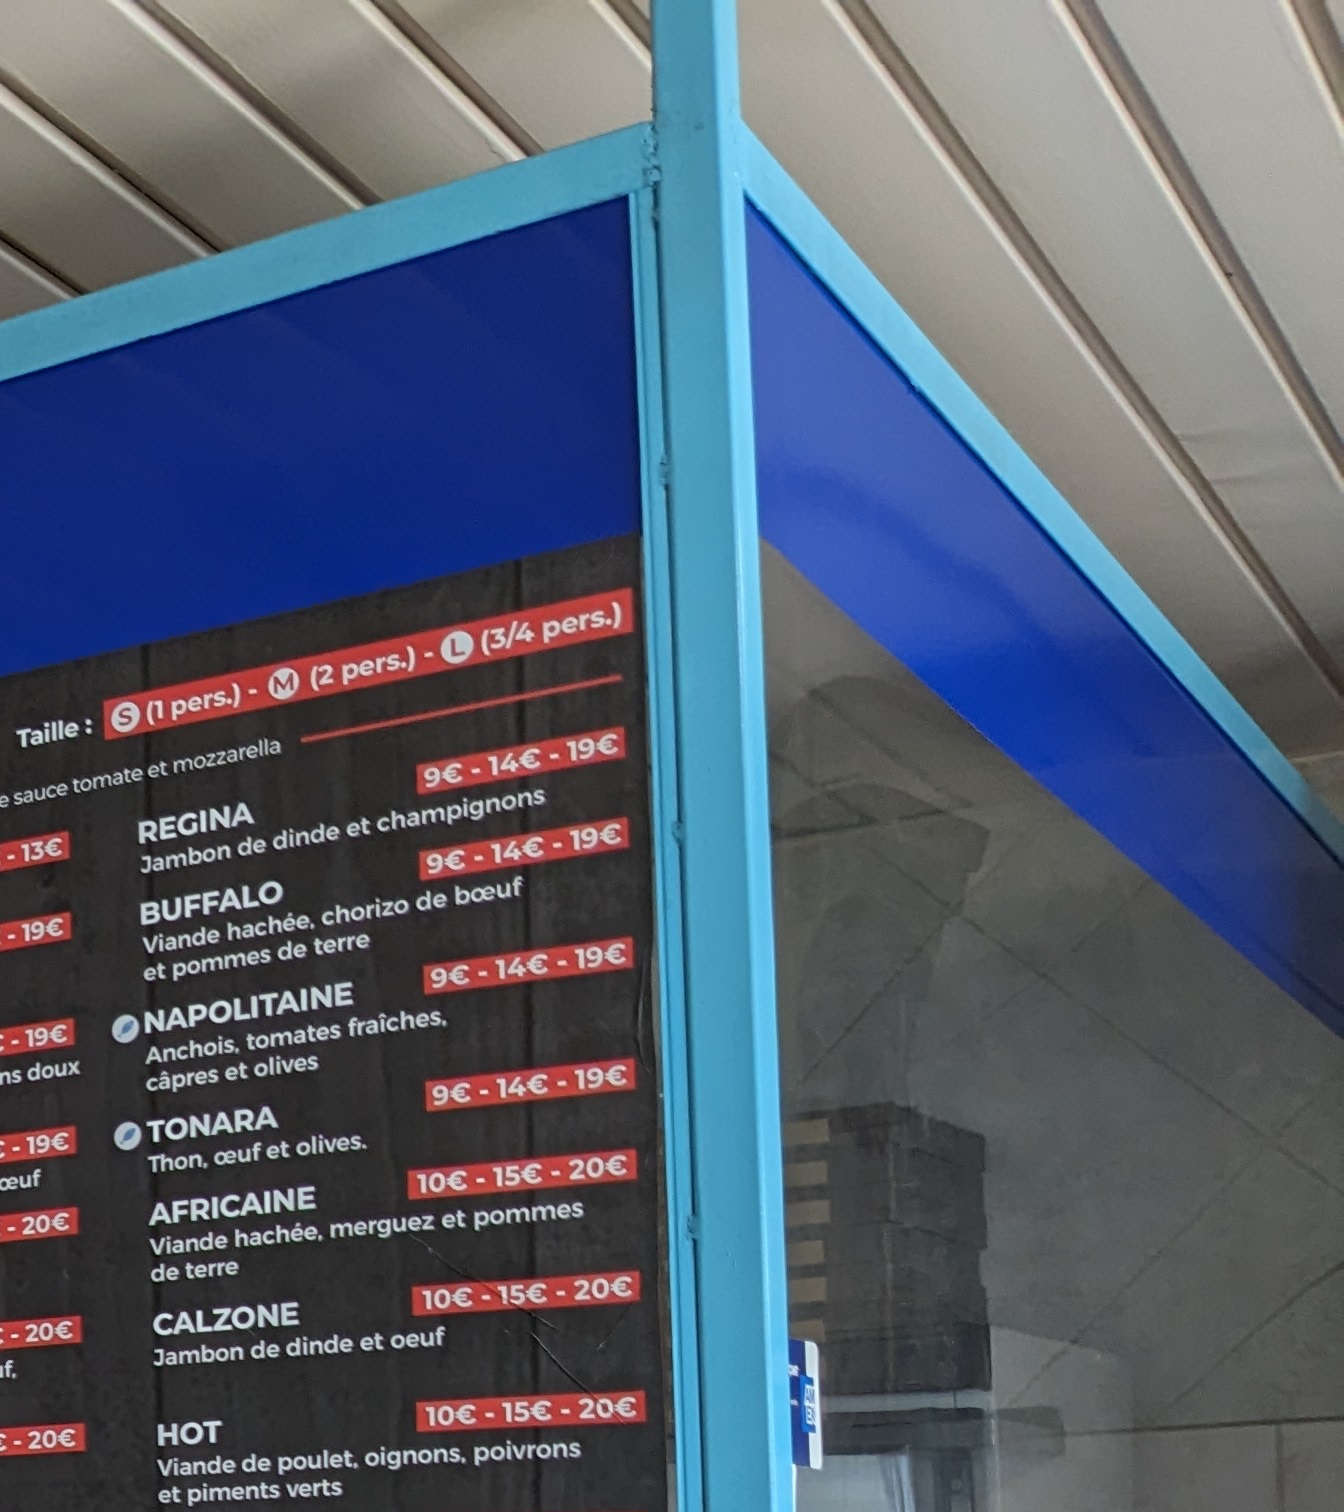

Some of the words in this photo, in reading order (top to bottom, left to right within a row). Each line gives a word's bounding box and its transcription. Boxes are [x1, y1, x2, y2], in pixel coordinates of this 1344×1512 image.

[15, 719, 80, 748] Taille
[146, 699, 164, 726] (1
[170, 682, 241, 721] pers.)
[310, 664, 334, 692] (2
[341, 645, 416, 686] pers.)
[480, 620, 535, 656] (3/4
[542, 601, 622, 644] pers.)
[13, 782, 69, 806] sauce
[71, 767, 144, 794] tomate
[147, 760, 169, 779] et
[172, 738, 282, 774] mozzarella
[424, 762, 463, 788] 9€
[487, 747, 541, 776] 14€
[566, 733, 619, 762] 19€
[137, 802, 255, 845] REGINA
[20, 837, 63, 862] 13€
[140, 880, 284, 926] BUFFALO
[143, 981, 354, 1034] NAPOLITAINE
[145, 1035, 240, 1065] Anchois,
[245, 1024, 342, 1051] tomates
[347, 1010, 447, 1037] fraîches,
[145, 1068, 219, 1093] câpres
[224, 1061, 249, 1081] et
[253, 1055, 319, 1078] olives
[145, 1105, 279, 1143] TONARA
[416, 1169, 468, 1194] 10€
[492, 1162, 543, 1187] 15€
[568, 1154, 628, 1180] 20€
[148, 1185, 317, 1226] AFRICAINE
[152, 1301, 300, 1336] CALZONE
[157, 1419, 223, 1447] HOT
